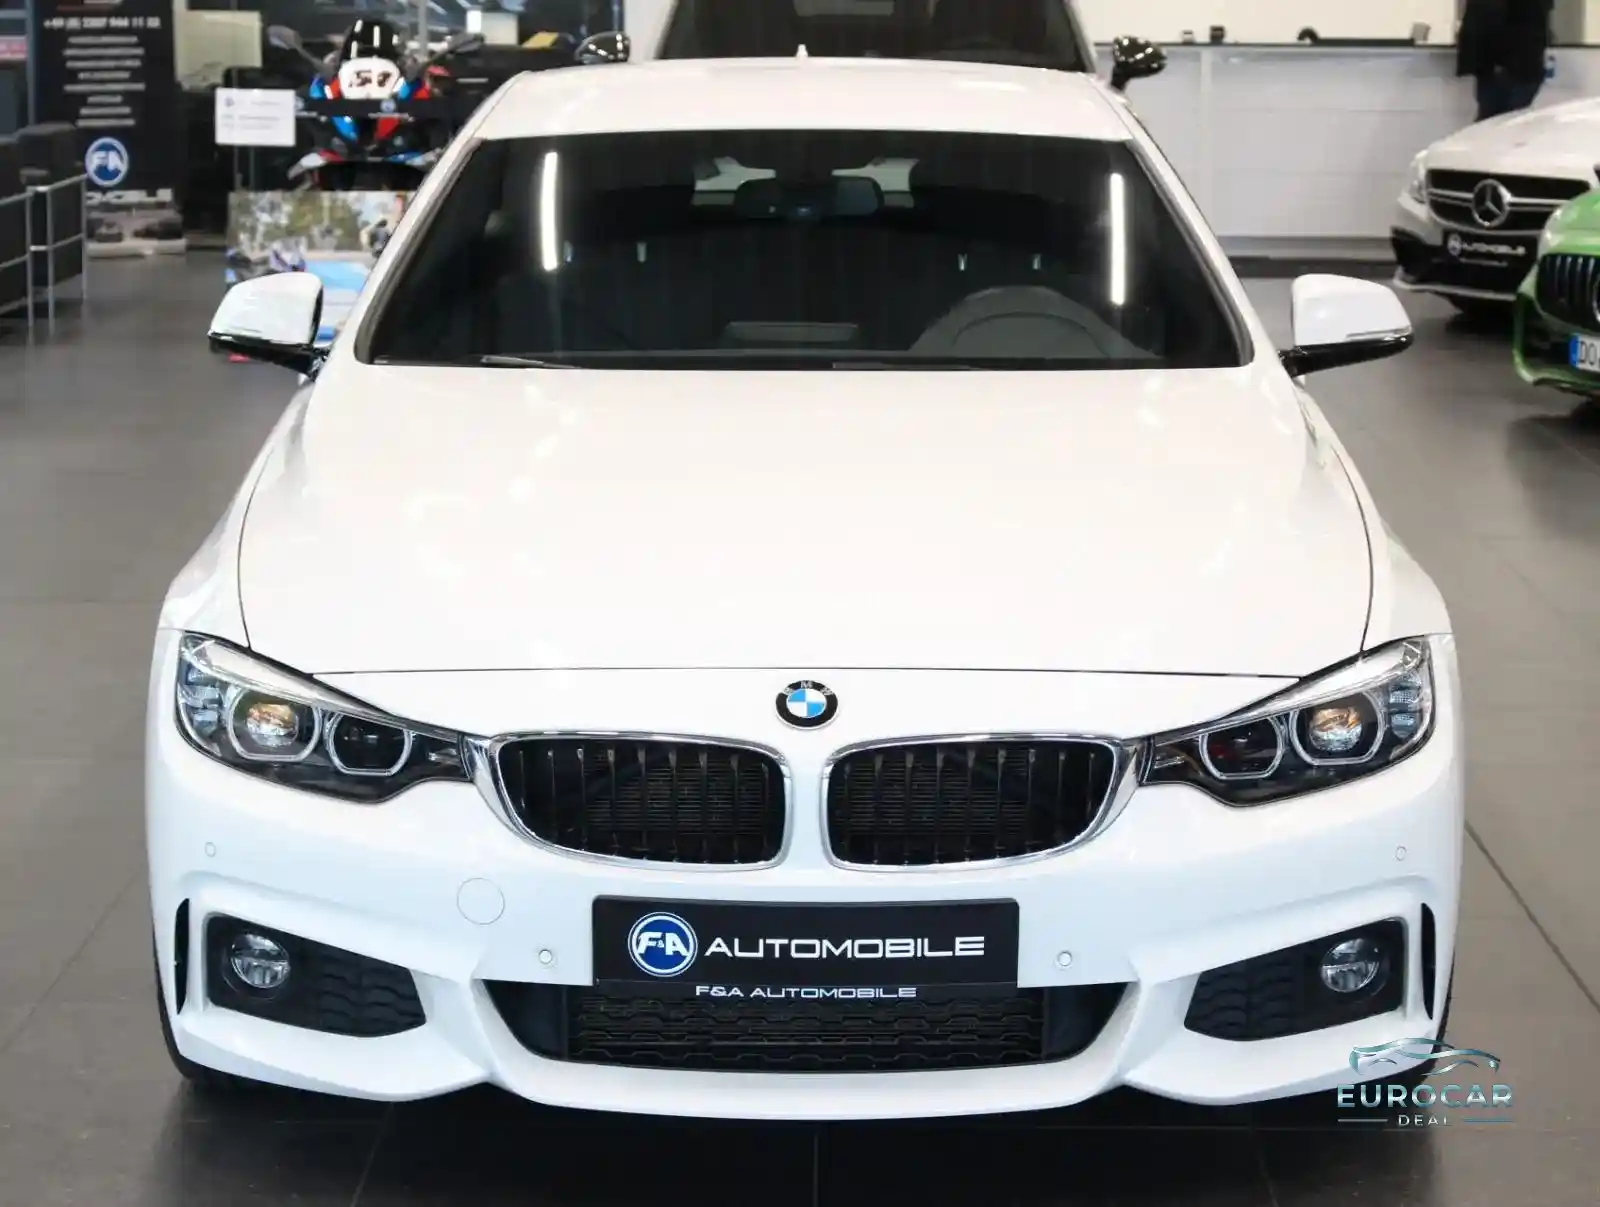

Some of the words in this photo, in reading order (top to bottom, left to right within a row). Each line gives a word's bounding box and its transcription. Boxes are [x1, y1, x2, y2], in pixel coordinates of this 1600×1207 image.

[637, 931, 690, 957] F&A
[704, 936, 985, 958] AUTOMOBILE
[695, 985, 744, 997] F&A
[750, 987, 917, 999] AUTOMOBILE
